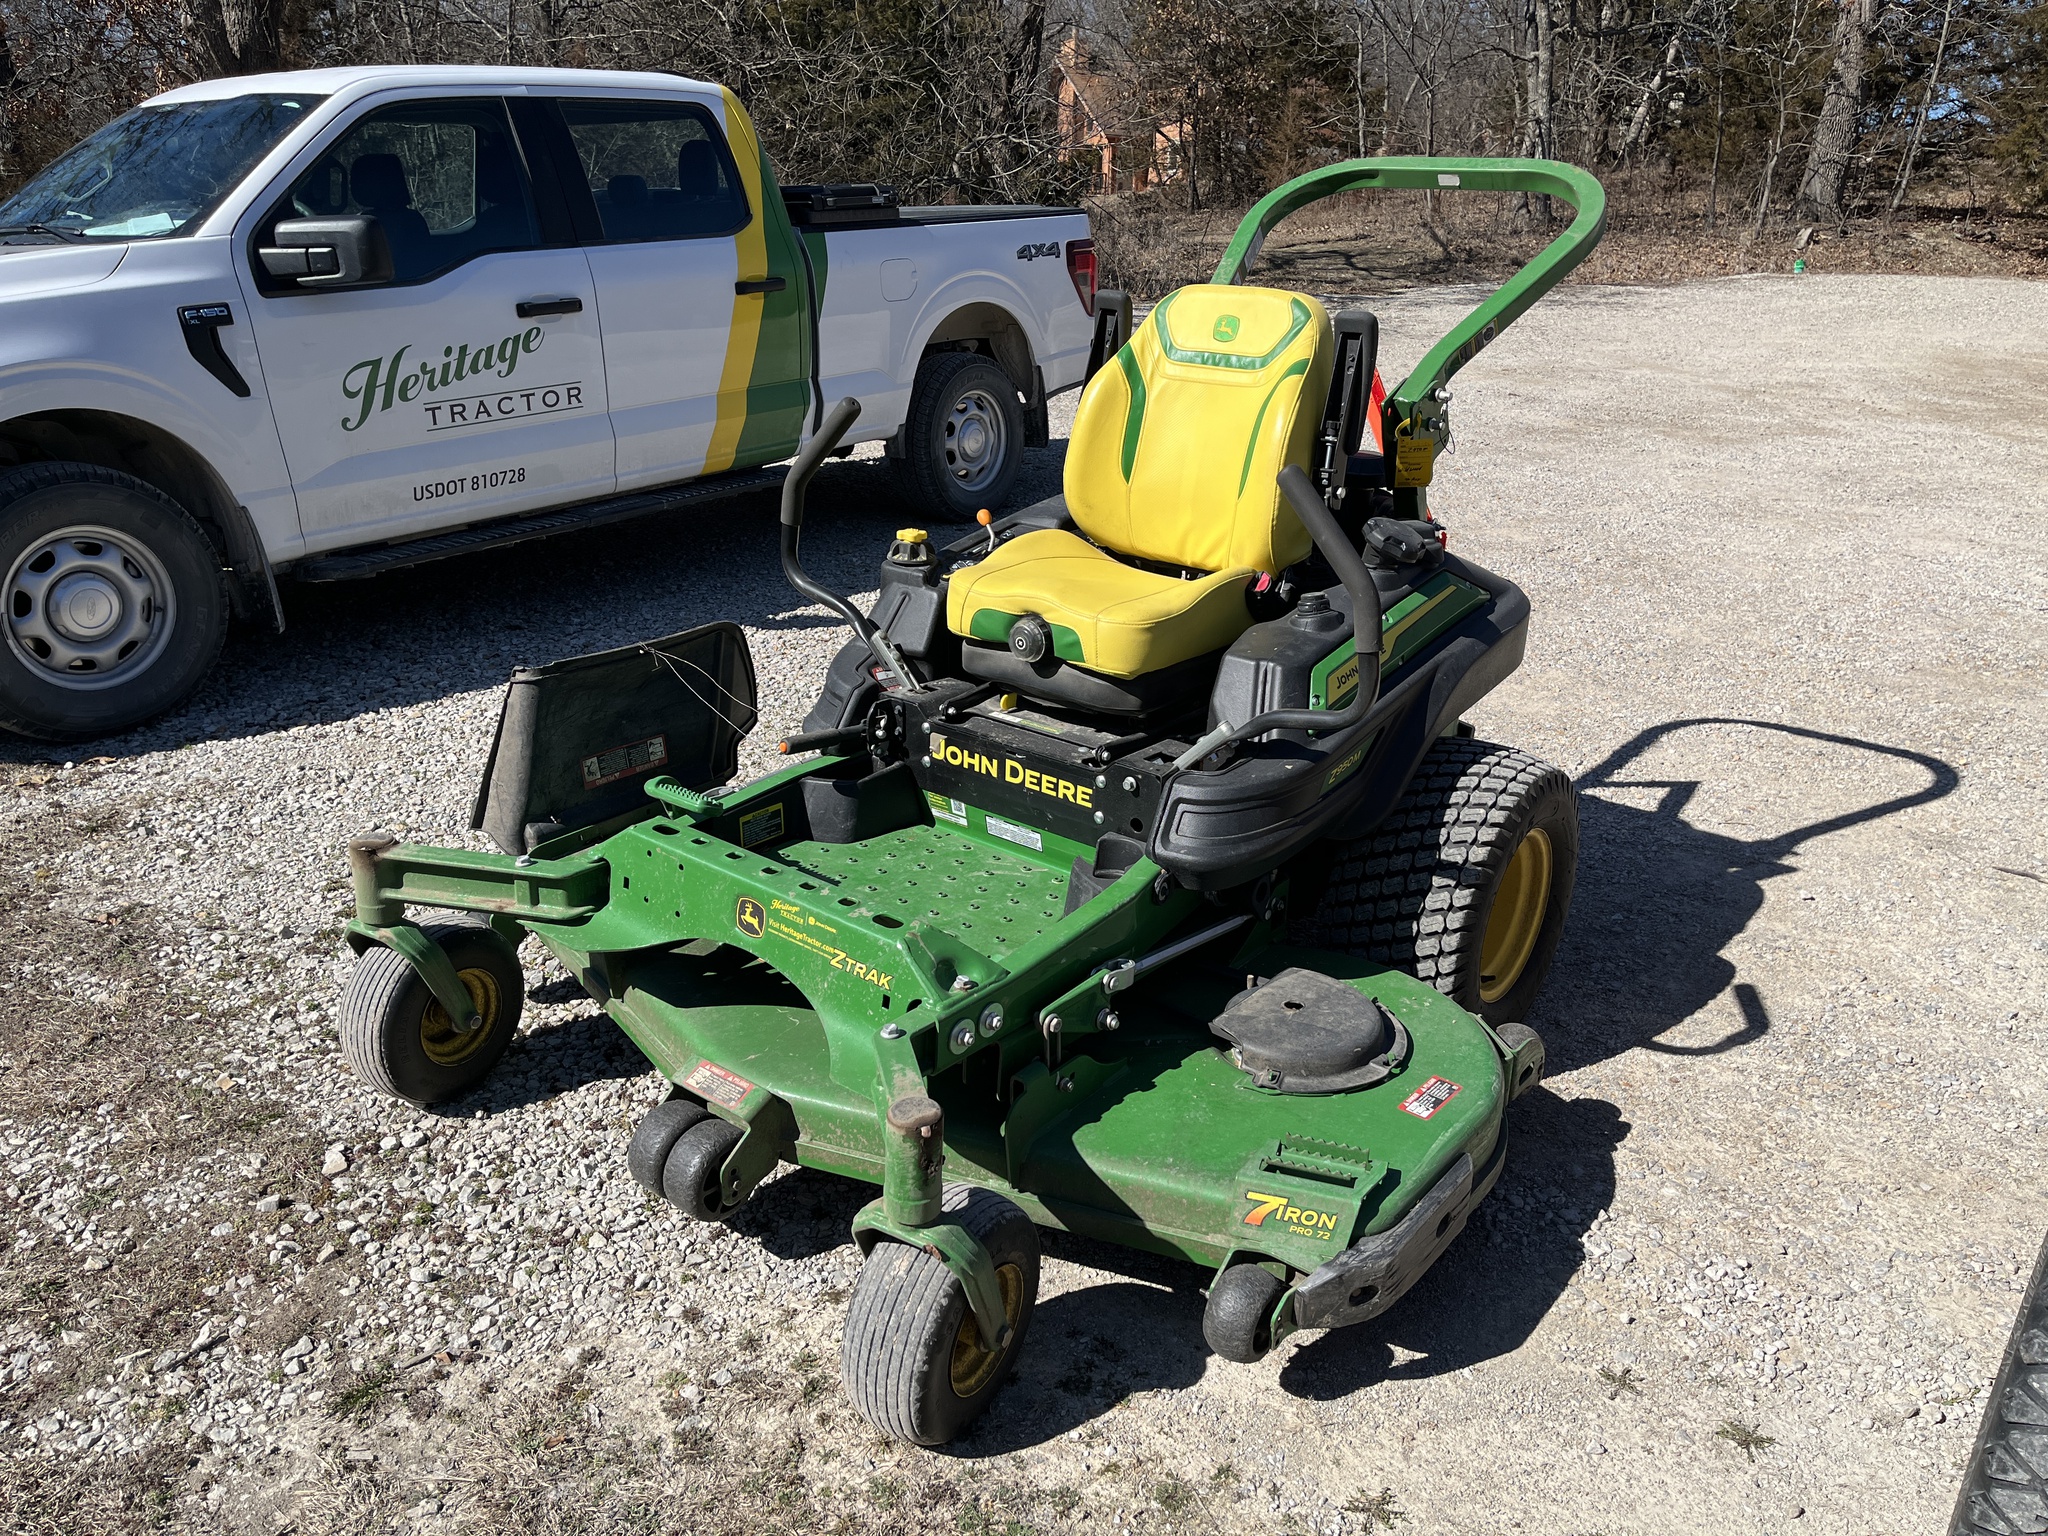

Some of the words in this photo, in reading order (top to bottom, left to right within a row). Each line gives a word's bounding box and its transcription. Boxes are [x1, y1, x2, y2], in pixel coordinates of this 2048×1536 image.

[185, 307, 228, 319] F-150
[341, 326, 545, 432] Heritage
[424, 386, 584, 426] TRACTOR
[413, 477, 466, 502] USDOT
[471, 467, 526, 491] 810728
[932, 738, 998, 778] JOHN
[1005, 758, 1093, 808] DEERE
[768, 918, 780, 929] Visit
[770, 899, 800, 913] Heritage
[829, 949, 894, 991] ZTRAK
[1289, 1225, 1313, 1237] PRO
[1316, 1230, 1331, 1240] 72
